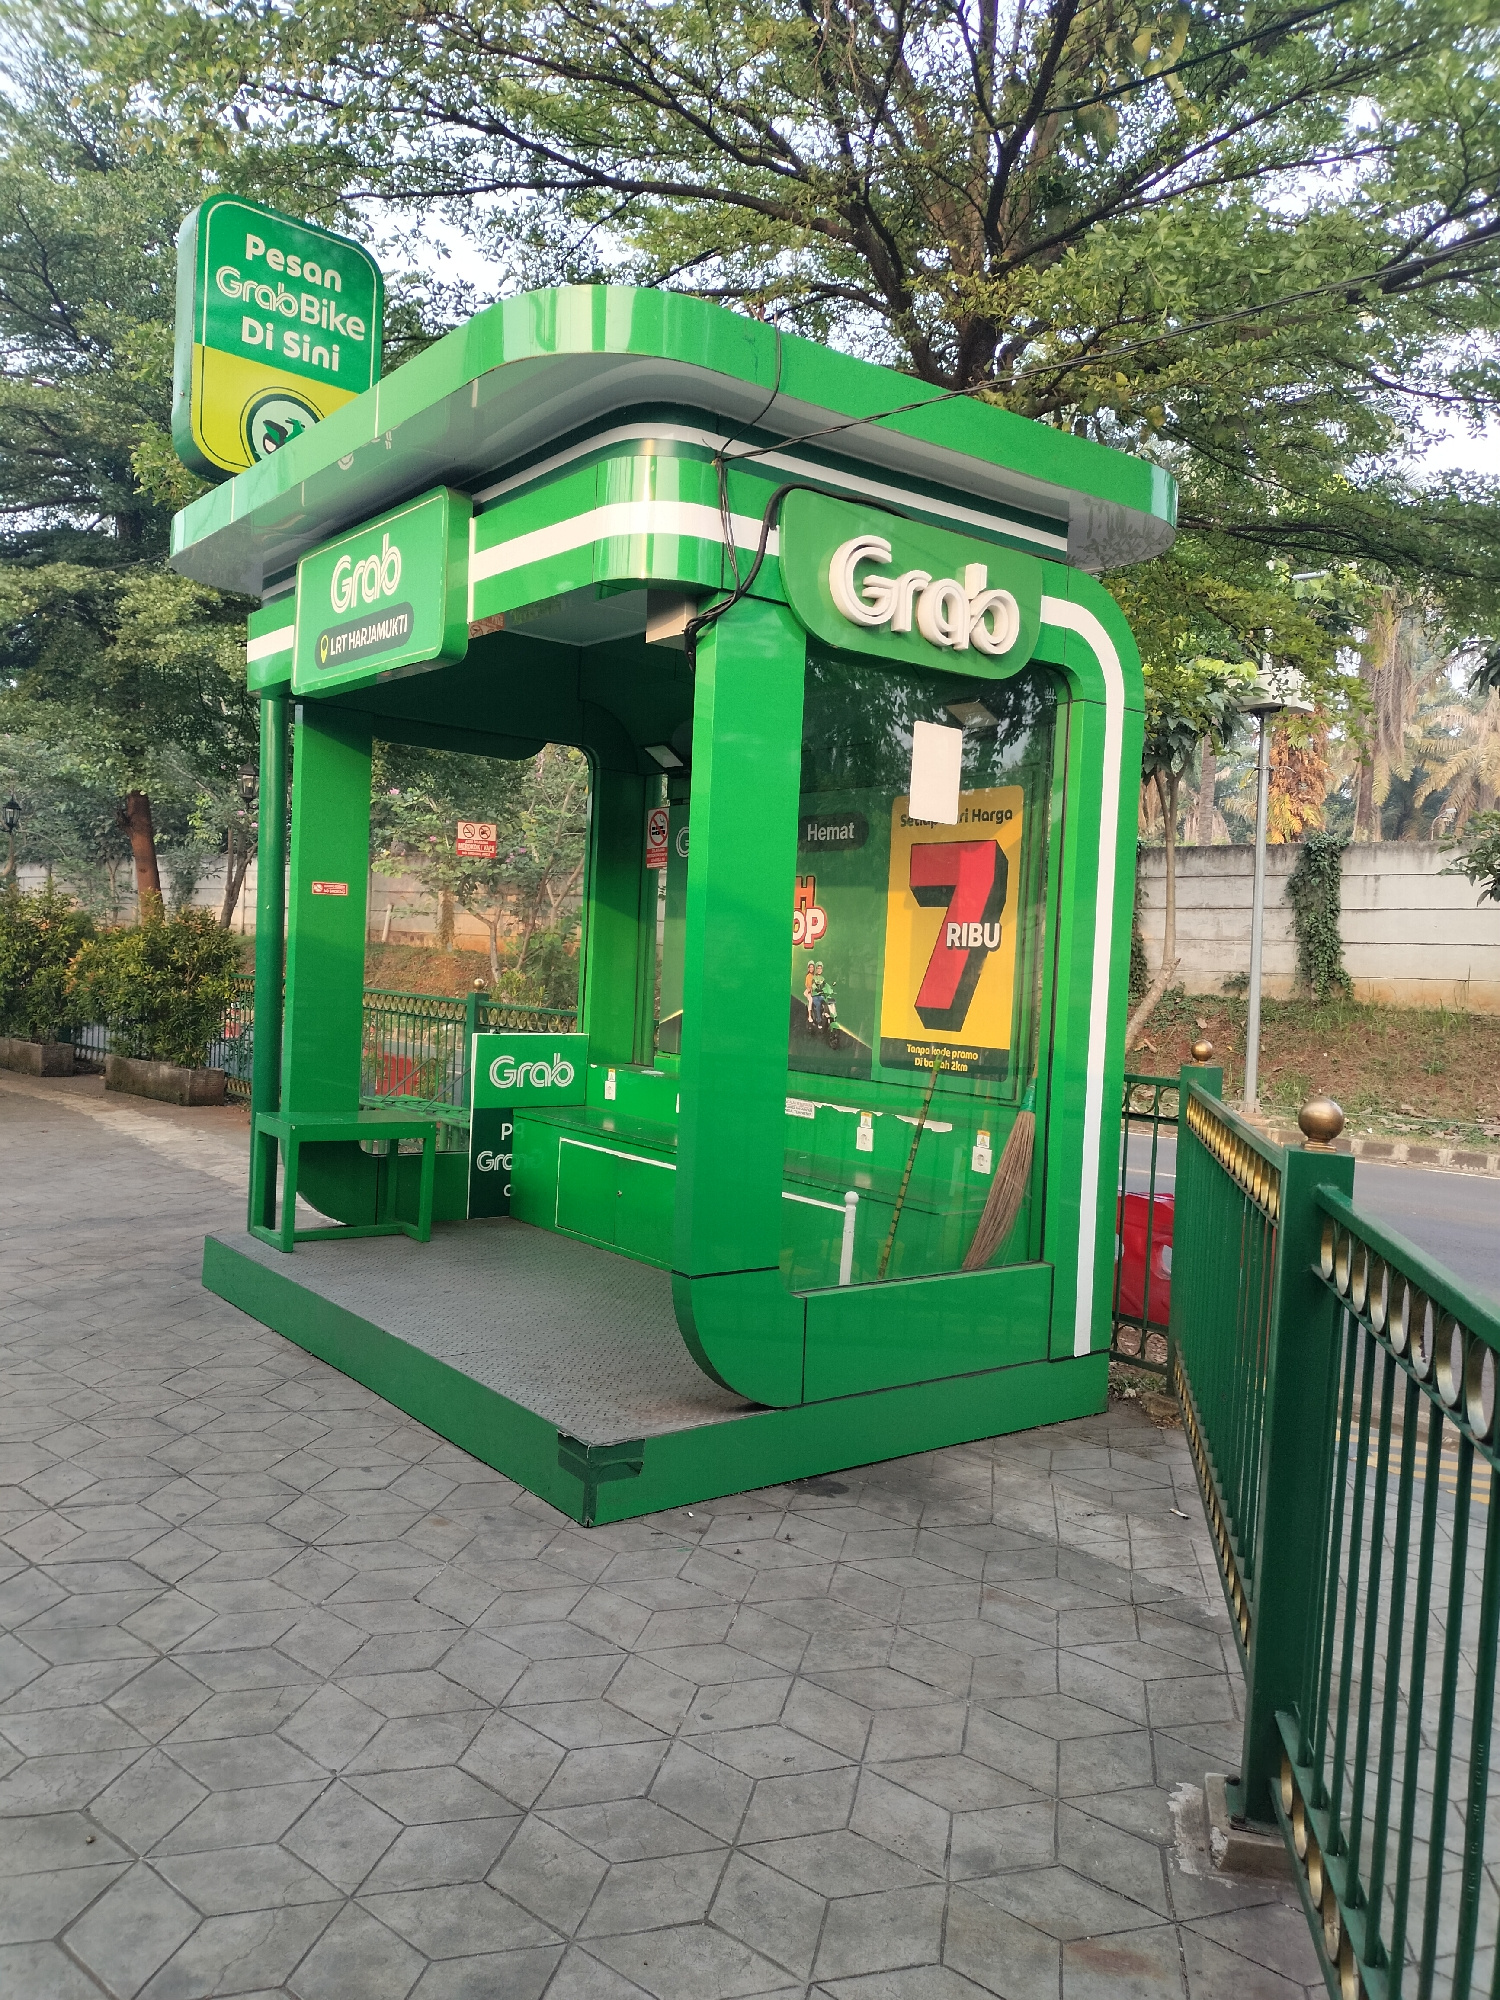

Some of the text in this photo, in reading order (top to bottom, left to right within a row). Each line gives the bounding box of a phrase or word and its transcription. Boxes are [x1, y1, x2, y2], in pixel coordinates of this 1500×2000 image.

[245, 233, 342, 292] Pesan
[215, 265, 366, 341] GrabBike
[241, 316, 340, 372] Di Sini
[330, 532, 402, 614] Grab
[828, 534, 1020, 655] Grab
[330, 613, 408, 656] LRT HARJAMUKTI
[807, 822, 855, 841] Hemat
[971, 808, 1013, 824] Harga
[909, 839, 1009, 1033] 7
[946, 922, 1001, 949] RIBU
[489, 1052, 575, 1089] Grab
[906, 1043, 979, 1061] Tanpa kode promo
[914, 1057, 968, 1072] Di baah 2km
